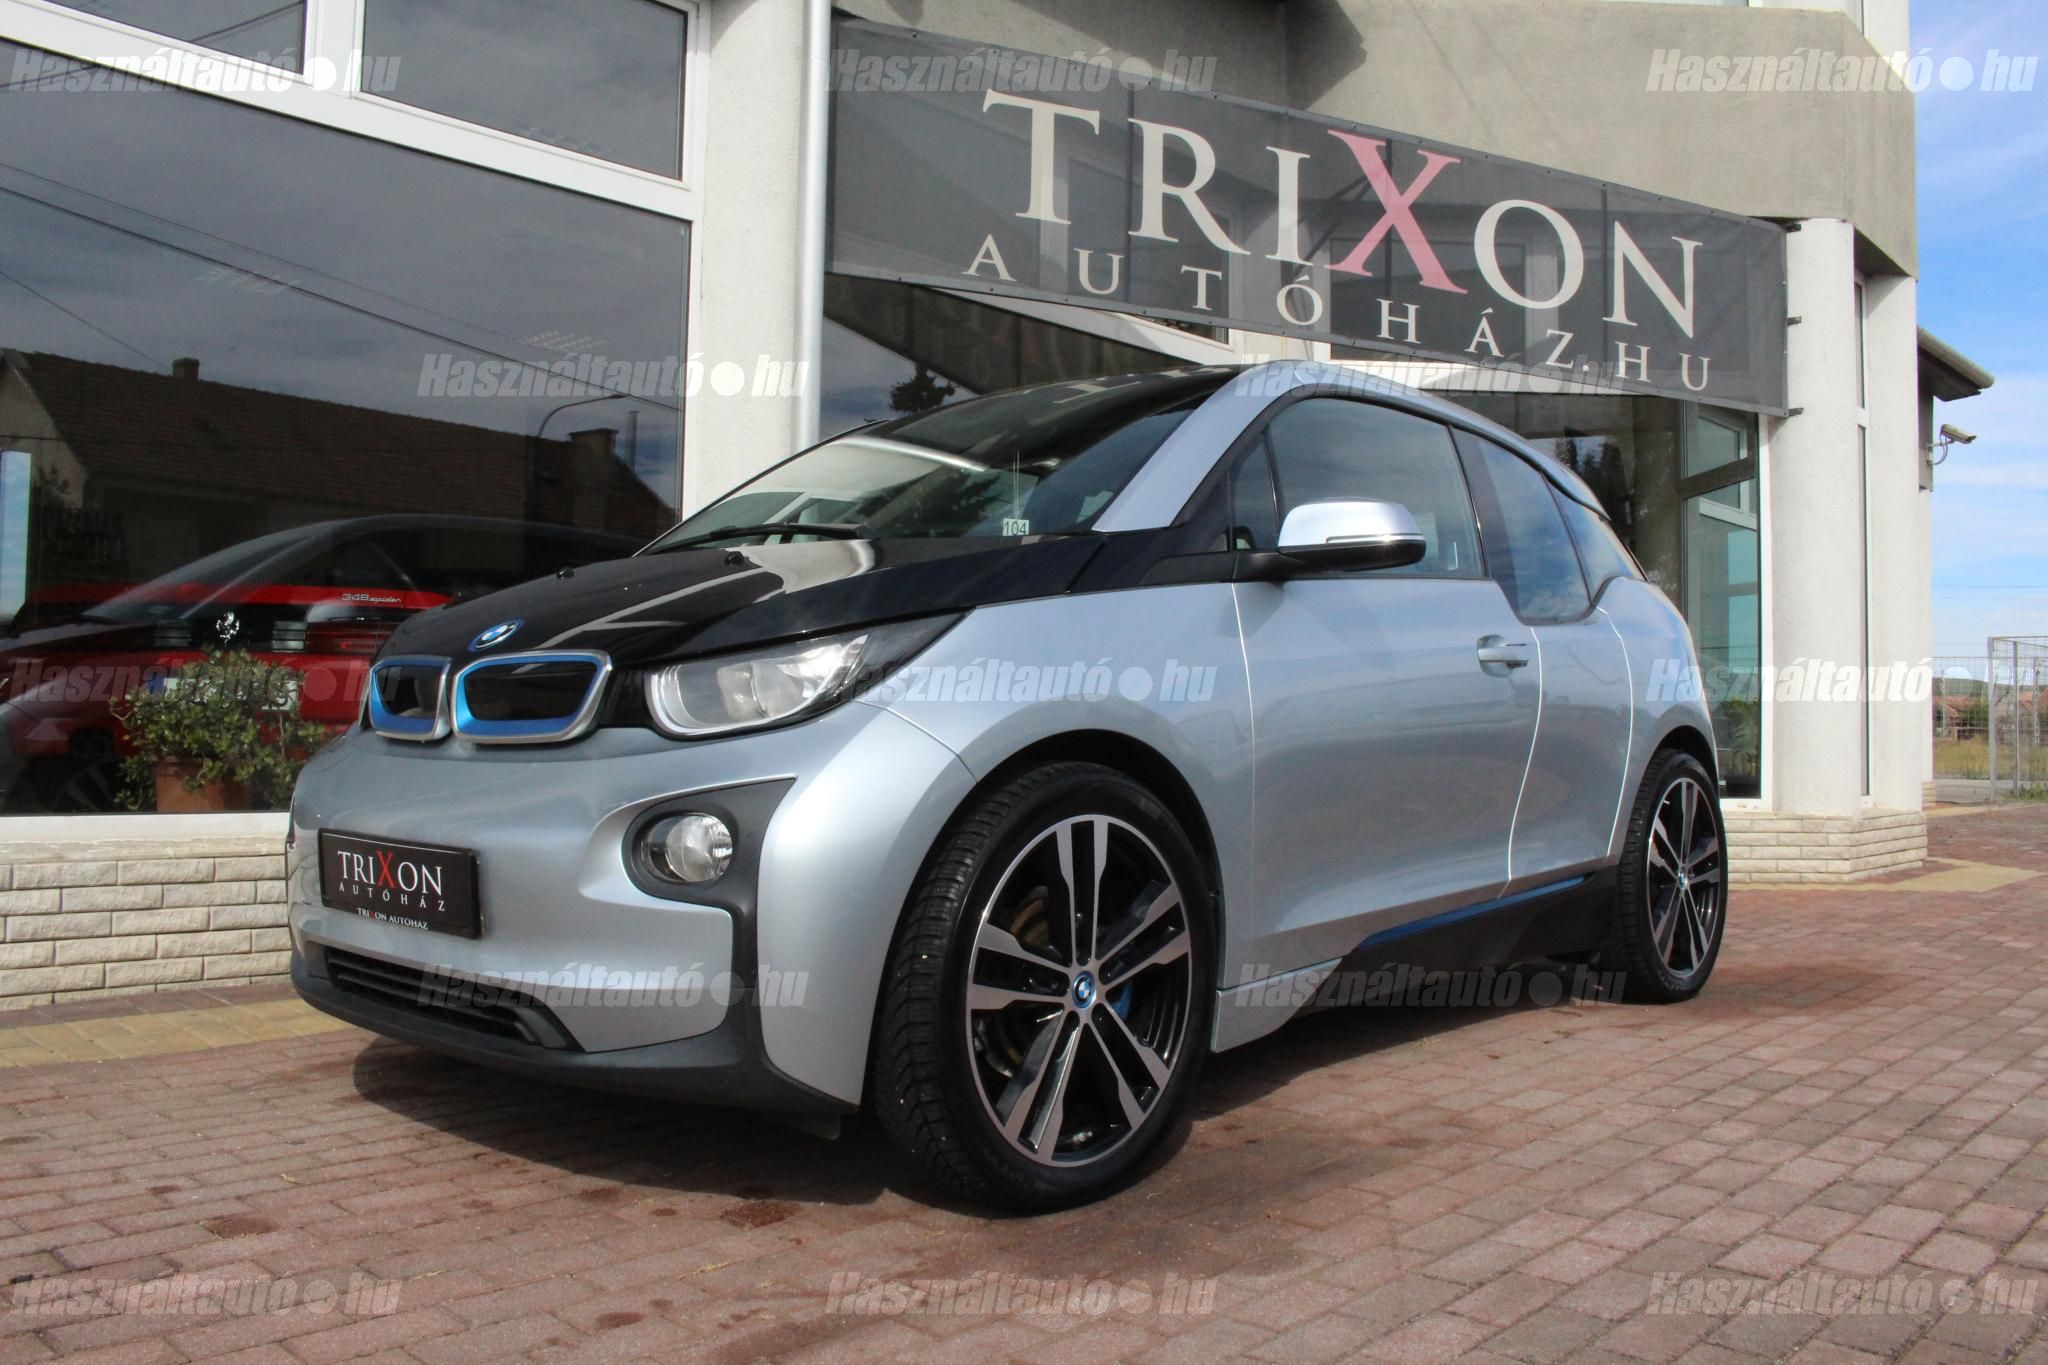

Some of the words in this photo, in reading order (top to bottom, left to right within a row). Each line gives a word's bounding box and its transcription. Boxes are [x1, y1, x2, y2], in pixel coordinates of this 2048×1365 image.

[983, 89, 1703, 338] TRIXON
[961, 234, 1711, 391] AUTÓHÁZ.HU
[1004, 520, 1027, 536] 104
[342, 593, 368, 601] 348
[369, 596, 402, 604] spider
[337, 850, 443, 896] TRIXON
[338, 881, 446, 912] AUTÓHÁZ
